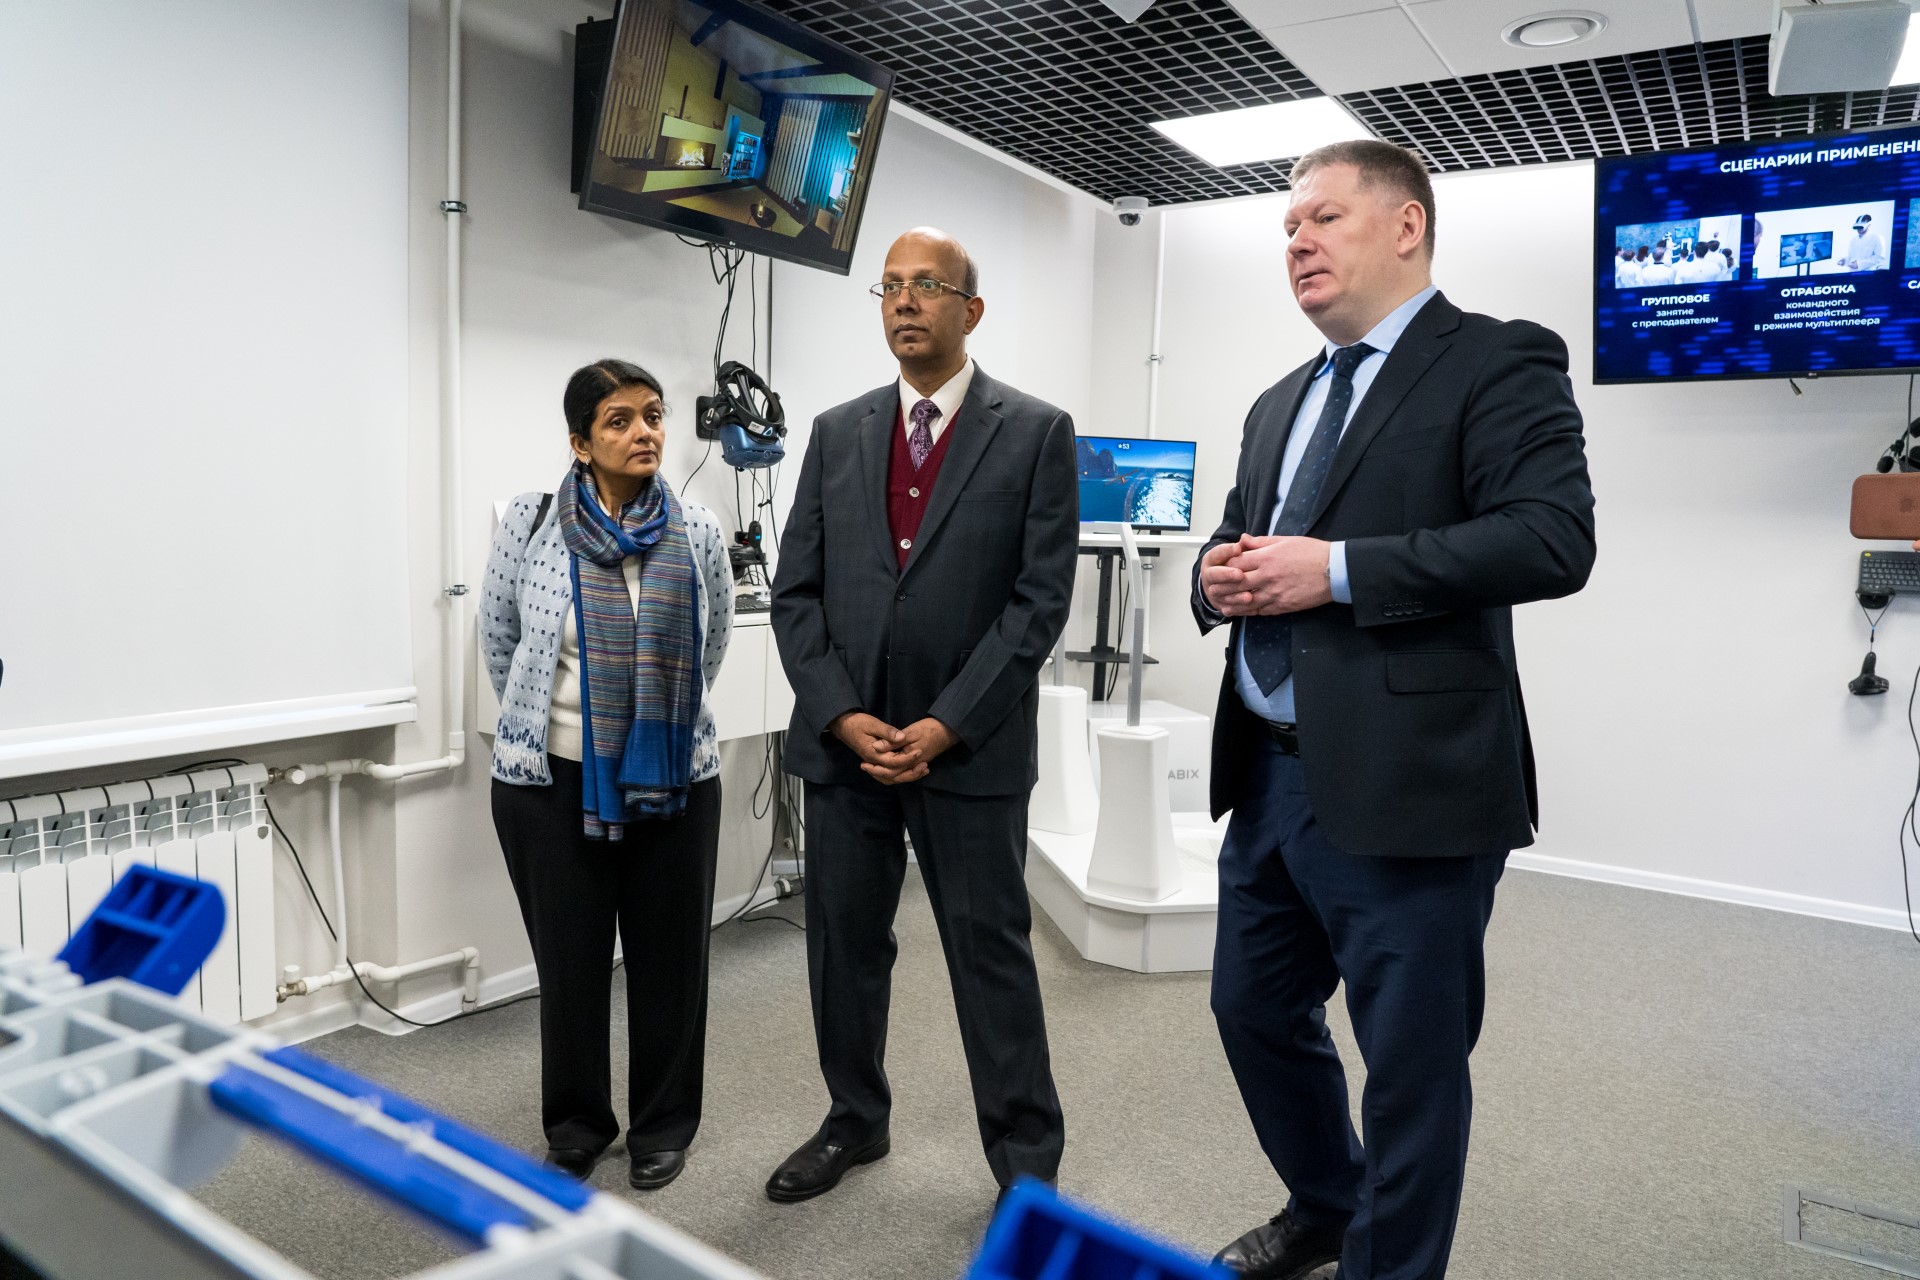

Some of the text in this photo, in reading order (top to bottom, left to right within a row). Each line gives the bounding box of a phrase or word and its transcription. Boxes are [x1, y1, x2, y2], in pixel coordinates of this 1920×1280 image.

[1720, 153, 1812, 173] СЦЕНАРИИ
[1781, 284, 1855, 298] ОТРАБОТКА
[1641, 294, 1710, 306] ГРУППОВОЕ
[1786, 298, 1849, 310] командного
[1656, 307, 1694, 317] занятие
[1774, 308, 1860, 320] взаимодействия
[1639, 316, 1719, 328] преподавателем
[1762, 321, 1804, 332] режиме
[1806, 317, 1880, 330] мультиплеера
